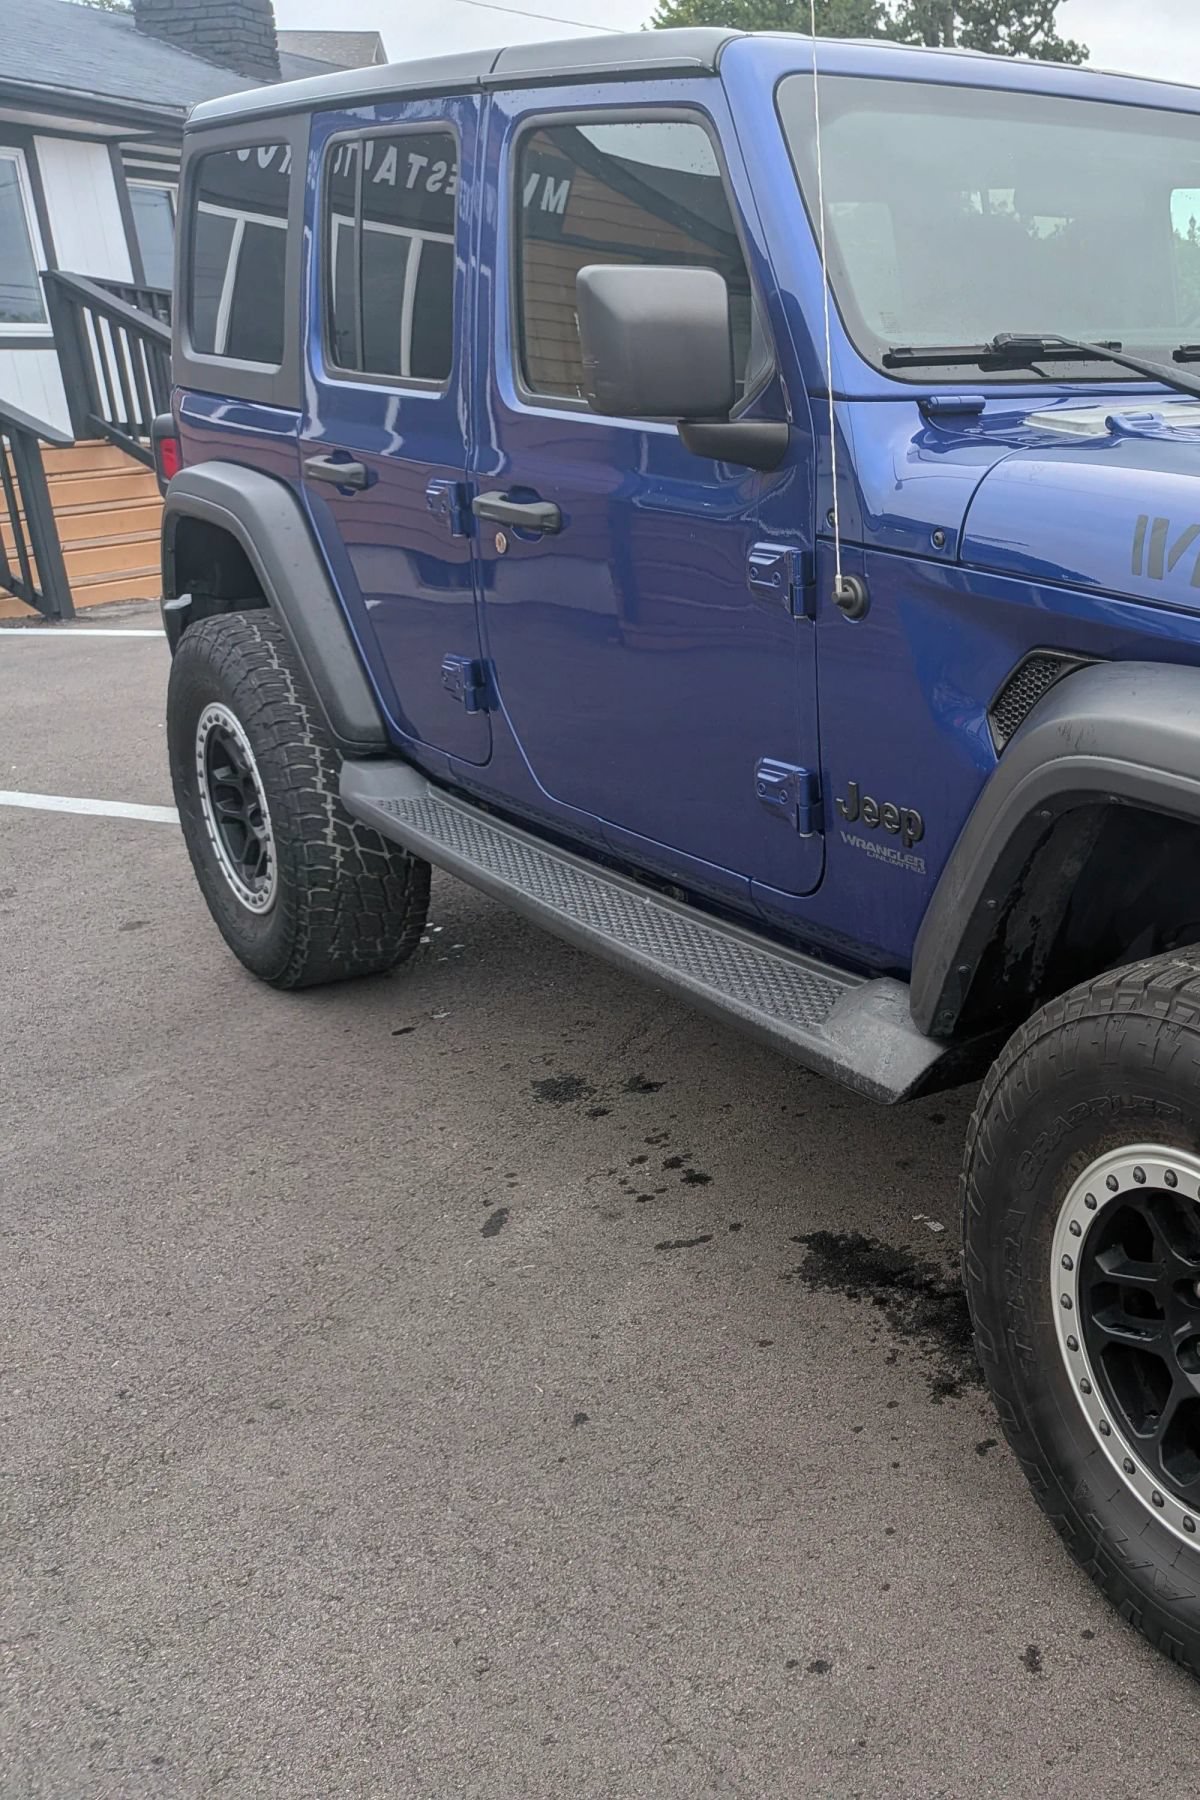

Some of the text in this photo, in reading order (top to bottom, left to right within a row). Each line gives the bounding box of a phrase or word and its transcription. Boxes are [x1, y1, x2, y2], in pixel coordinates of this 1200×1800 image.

[835, 781, 925, 849] Jeep
[840, 831, 925, 869] WRANGLER
[866, 851, 926, 874] UNLIMITED
